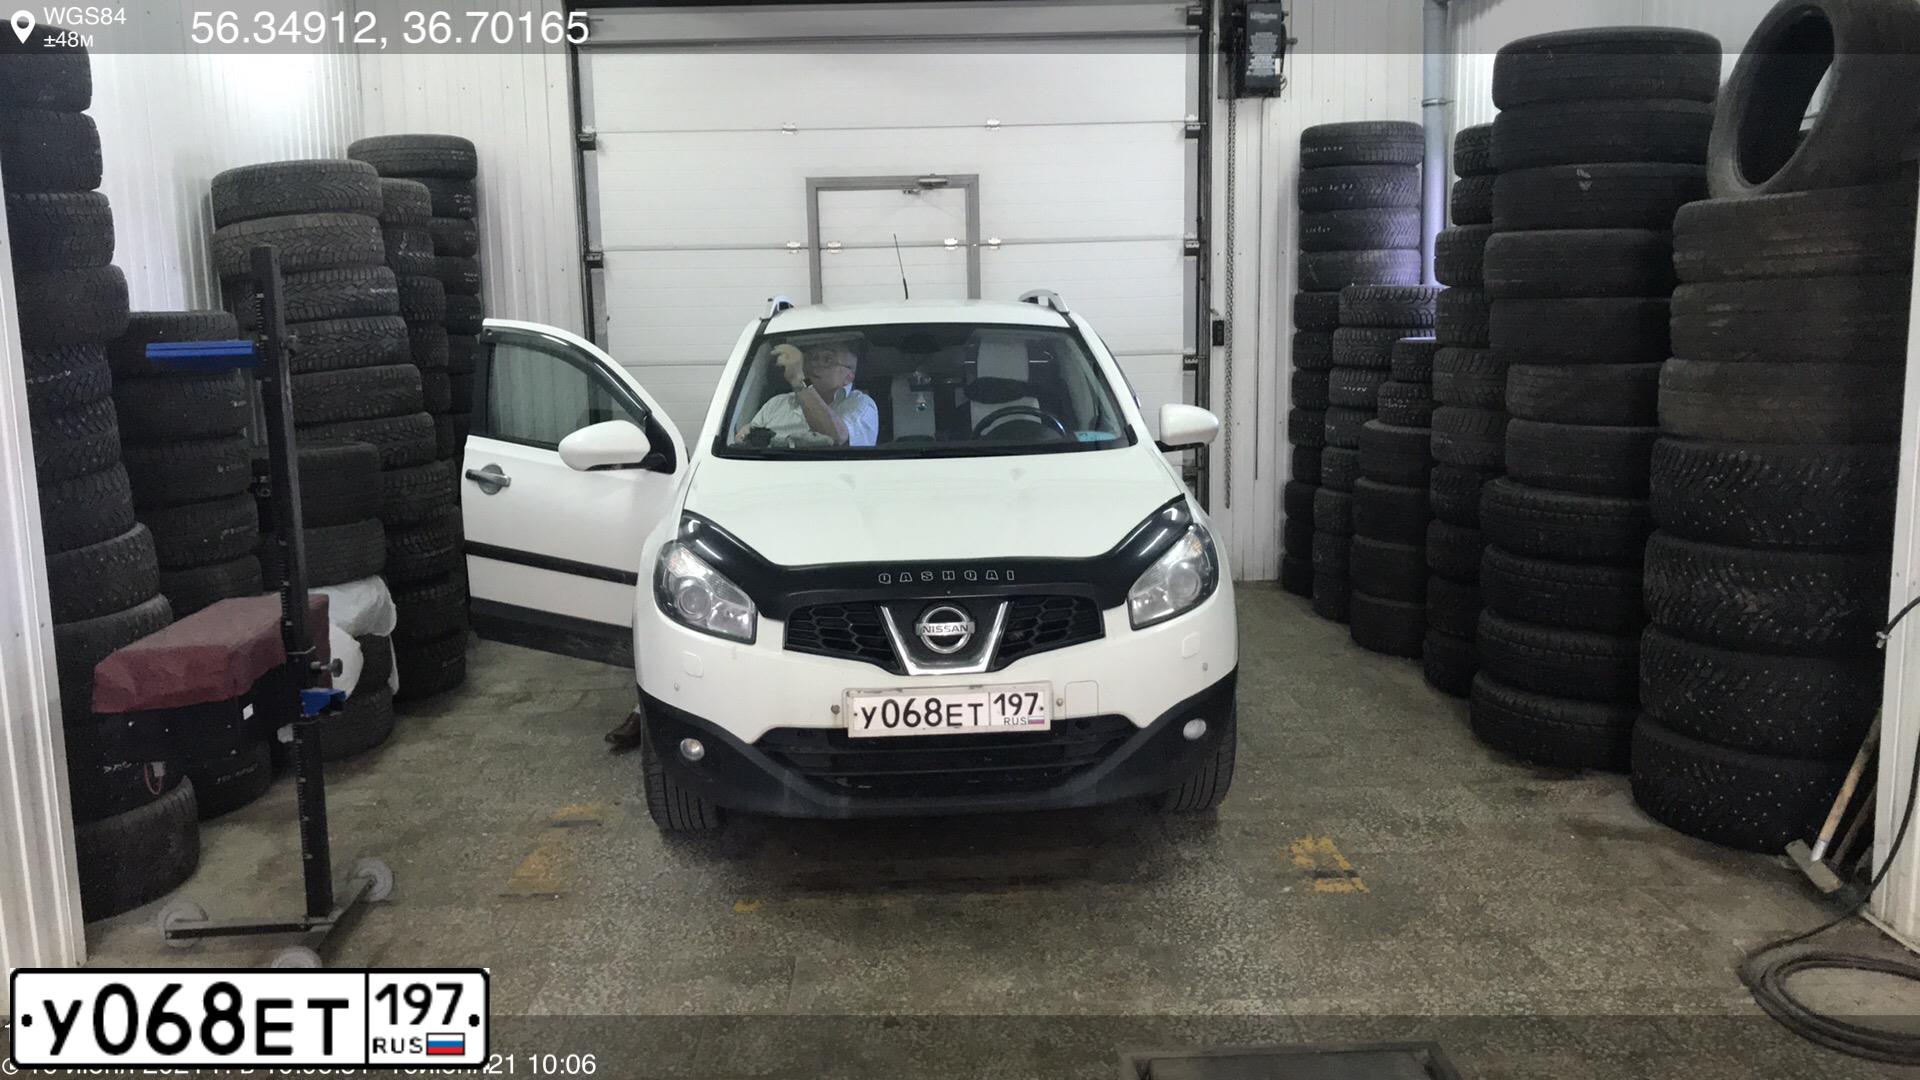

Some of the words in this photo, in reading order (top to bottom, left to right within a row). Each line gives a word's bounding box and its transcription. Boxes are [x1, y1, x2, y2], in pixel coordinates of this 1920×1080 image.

[878, 569, 1015, 585] QASHQAI
[922, 624, 969, 634] NISSAN
[993, 692, 1038, 716] 197
[1003, 716, 1026, 726] RUS
